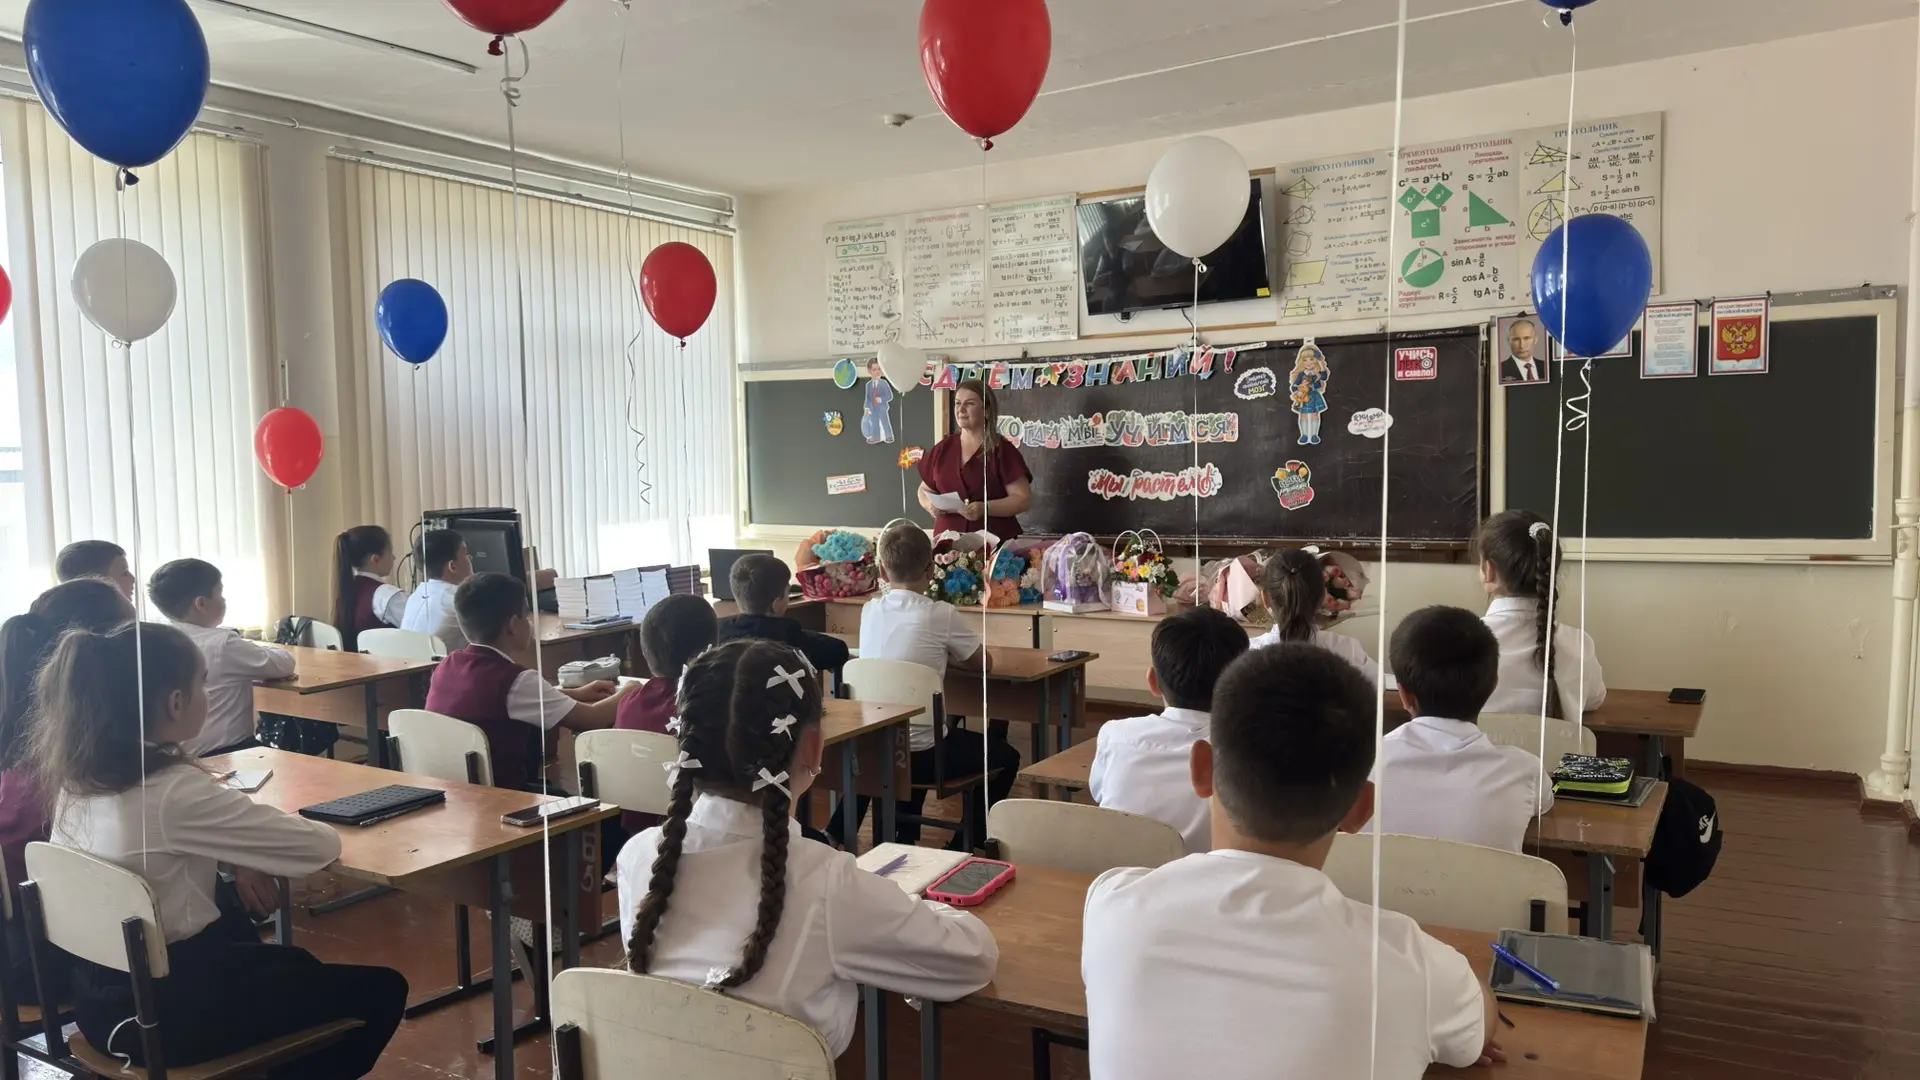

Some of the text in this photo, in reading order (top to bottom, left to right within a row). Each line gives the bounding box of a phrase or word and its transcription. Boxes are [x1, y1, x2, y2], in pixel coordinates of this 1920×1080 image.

[1463, 138, 1513, 150] ТРЕУГОЛЬНИК
[1407, 157, 1439, 166] ТЕОРЕМА
[1405, 164, 1442, 173] ПИФАГОРА
[1474, 289, 1482, 298] tg
[1398, 350, 1434, 360] УЧИСЬ
